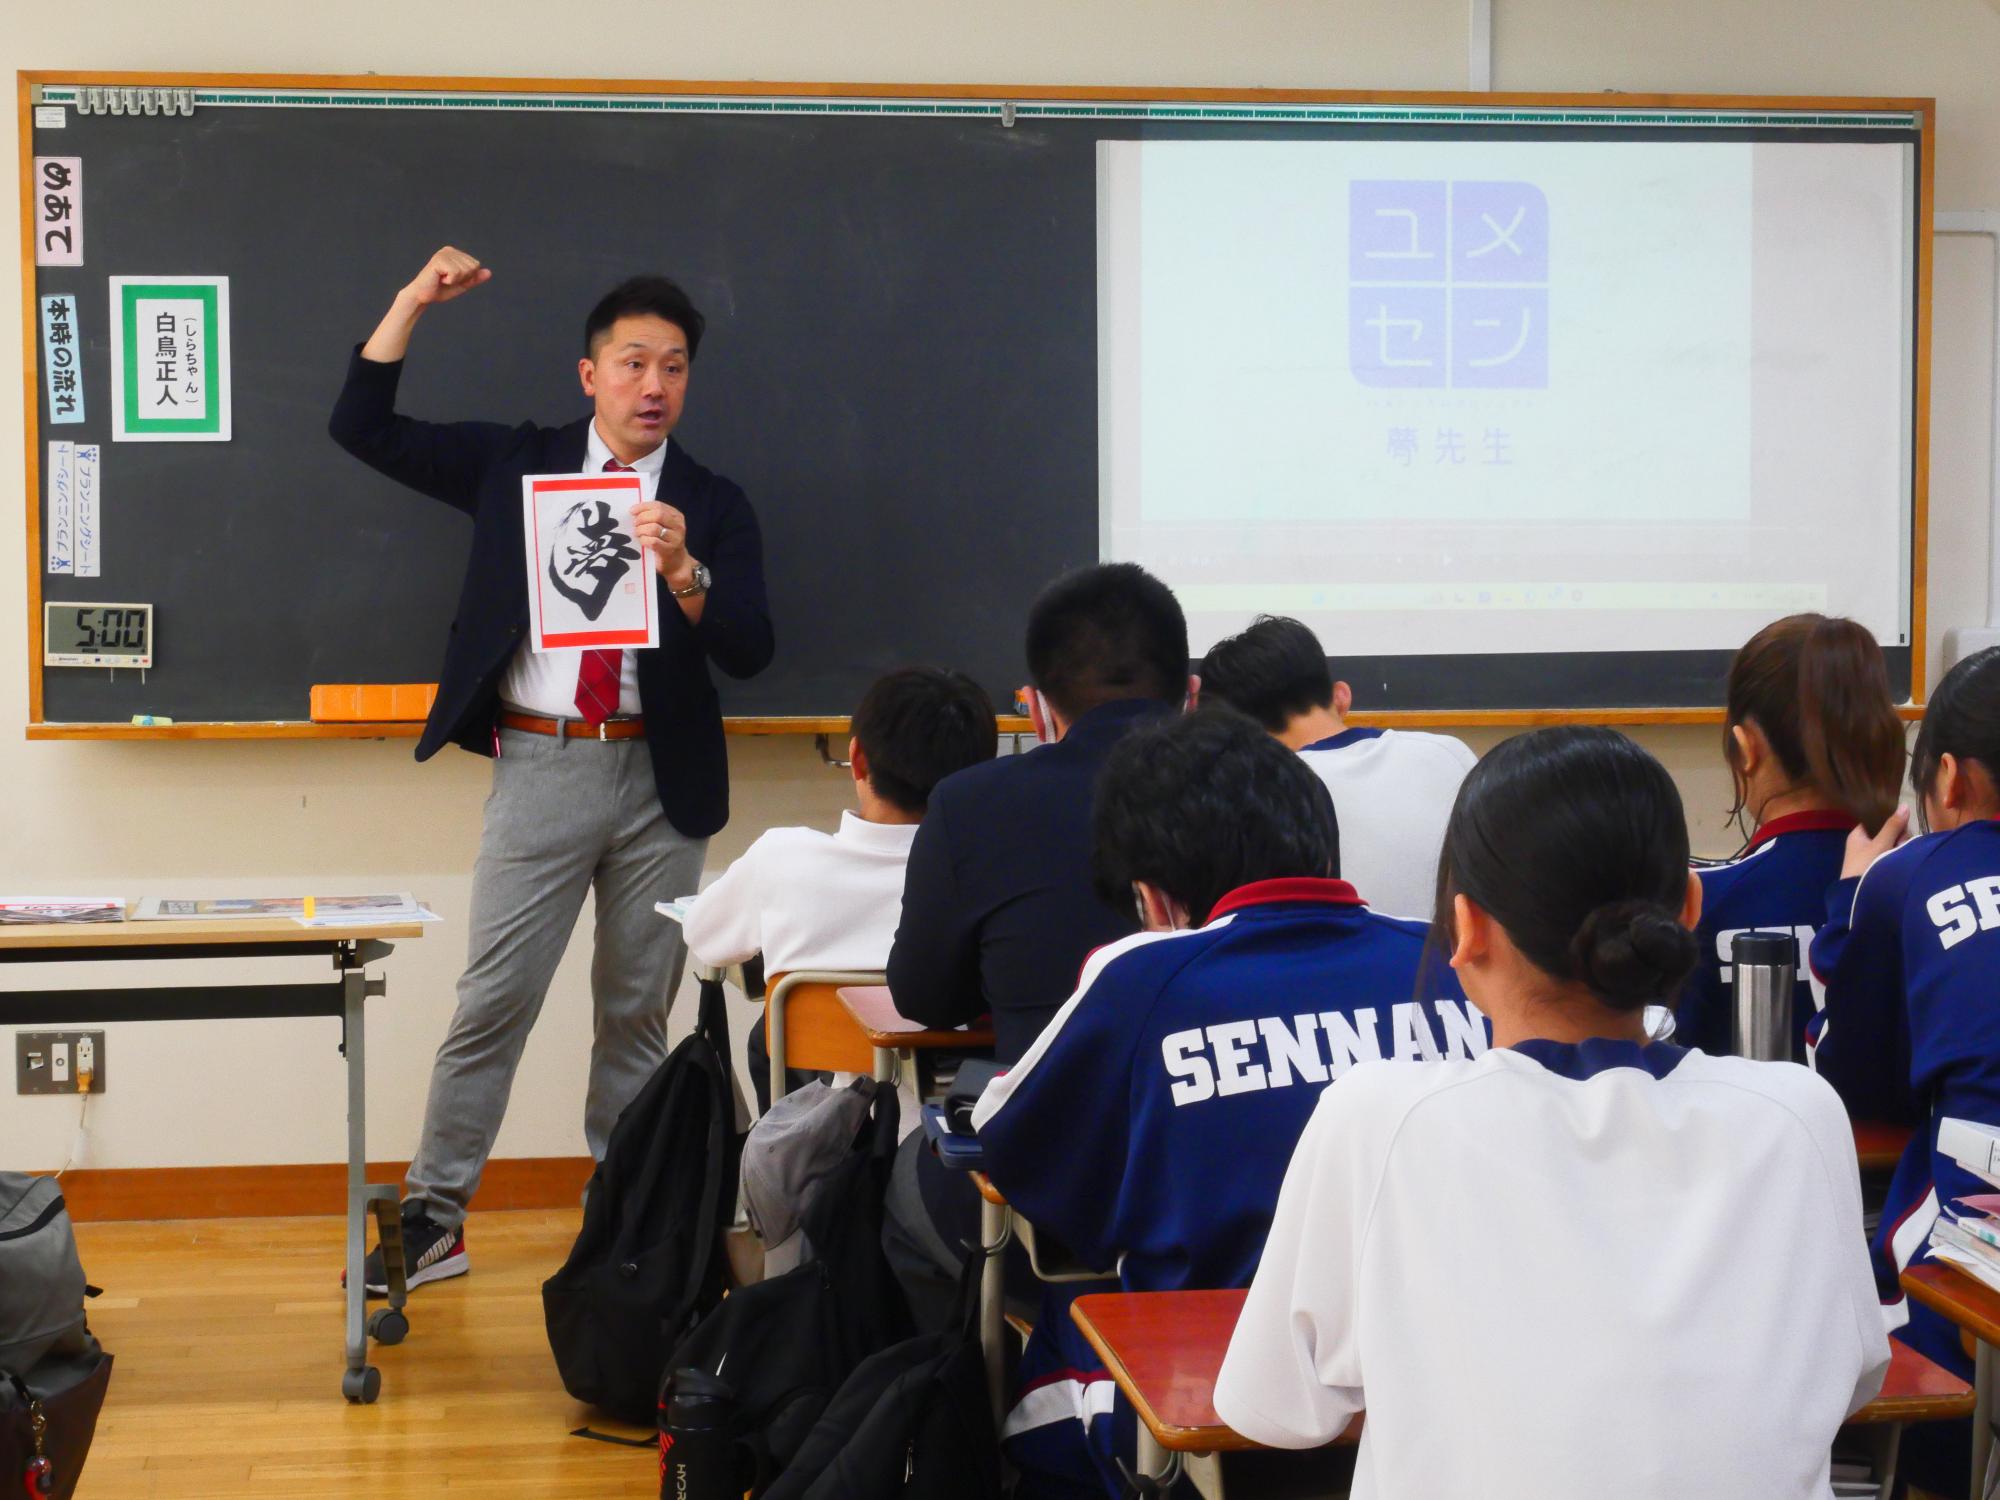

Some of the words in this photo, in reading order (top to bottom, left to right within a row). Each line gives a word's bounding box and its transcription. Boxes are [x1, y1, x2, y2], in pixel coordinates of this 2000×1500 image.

[43, 162, 72, 253] めあて
[47, 298, 77, 416] 本時の流れ
[155, 312, 178, 406] 白鳥正人
[75, 609, 146, 648] 5:00
